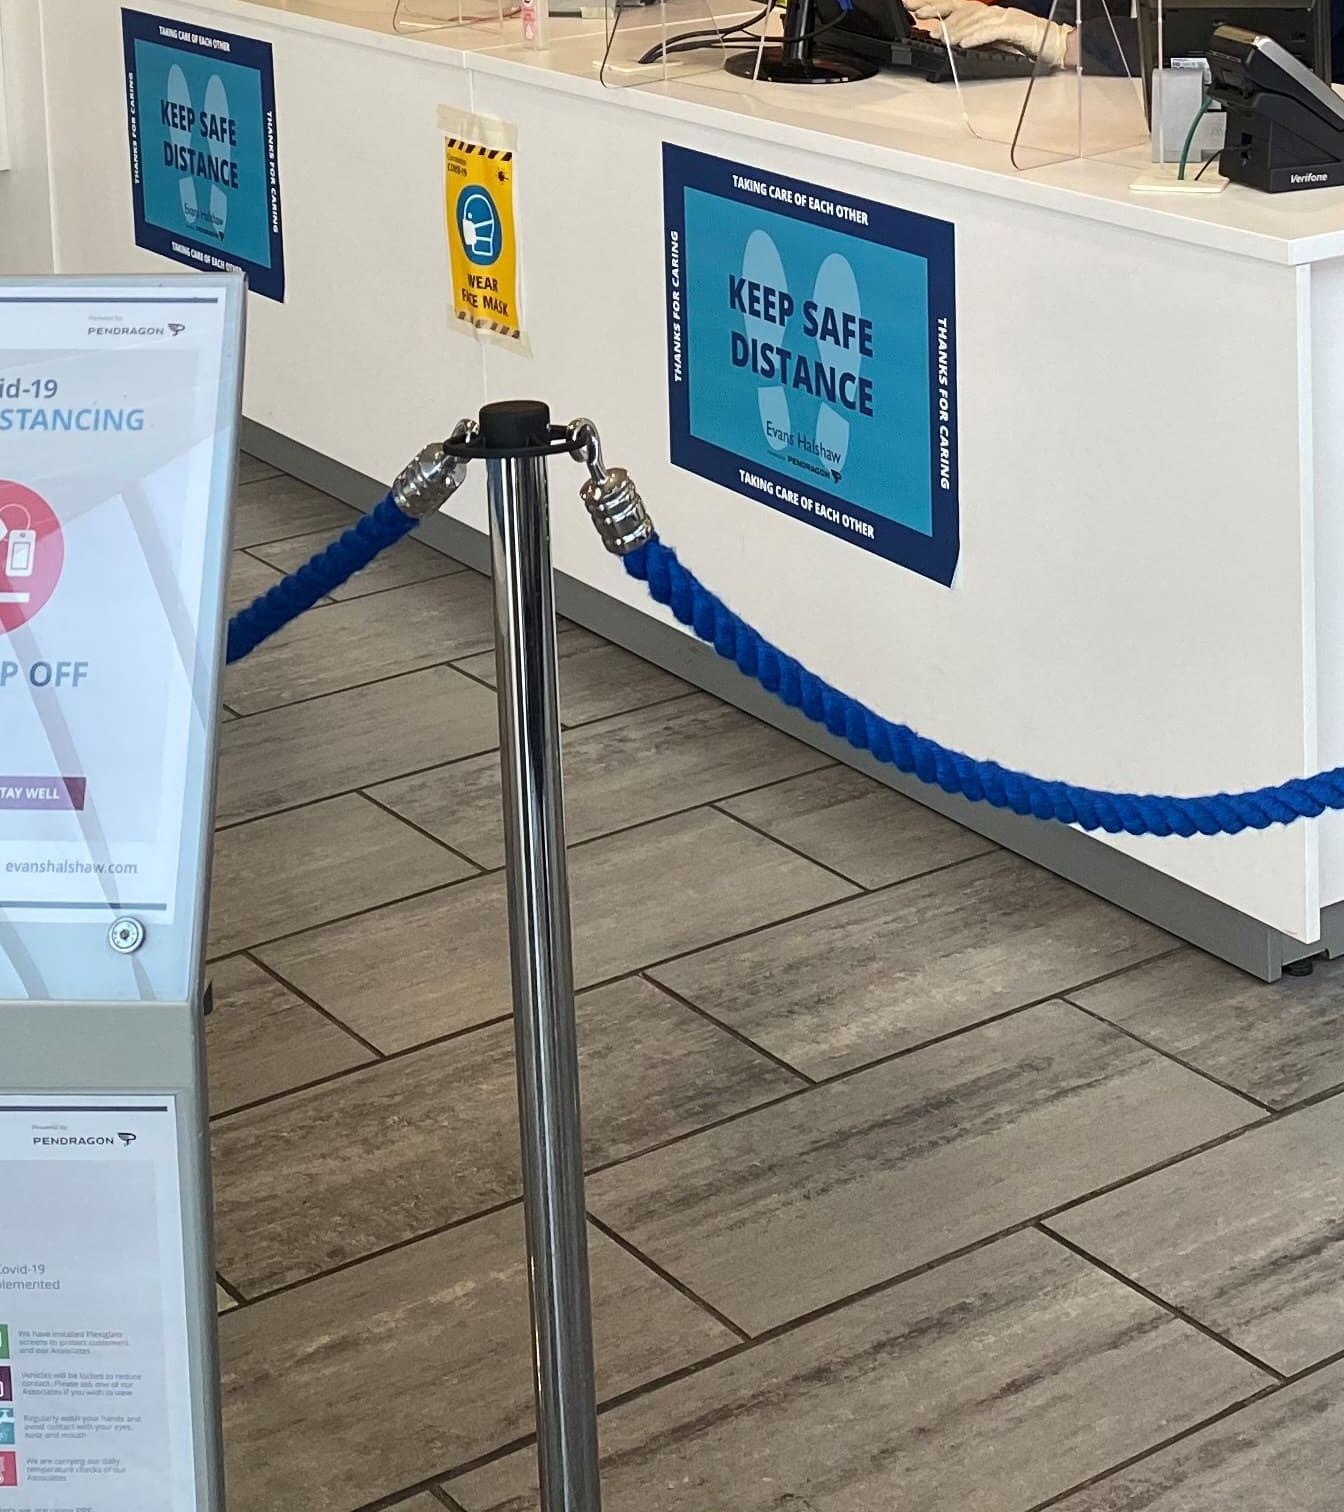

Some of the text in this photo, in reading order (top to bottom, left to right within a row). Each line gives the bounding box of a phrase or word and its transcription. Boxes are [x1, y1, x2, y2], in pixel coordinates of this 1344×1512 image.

[161, 99, 236, 146] KEEP SAFE
[163, 140, 239, 189] DISTANCE
[1290, 173, 1328, 183] Verifone
[732, 175, 869, 226] TAKING CARE OF EACH OTHER
[467, 273, 498, 293] WEAR
[483, 295, 508, 316] MASK
[671, 231, 682, 382] THANKS FOR CARING
[729, 274, 873, 358] KEEP SAFE
[88, 326, 164, 335] PENDRAGON
[731, 332, 874, 417] DISTANCE
[937, 317, 950, 490] THANKS FOR CARING
[766, 420, 841, 464] Evans Halshaw
[788, 456, 830, 479] PENDRAGON
[739, 470, 875, 539] TAKING CARE OF EACH OTHER
[29, 661, 88, 687] OFF
[25, 788, 59, 800] WELL
[5, 860, 137, 875] evanshalshaw.com
[33, 1136, 114, 1145] PENDRAGON
